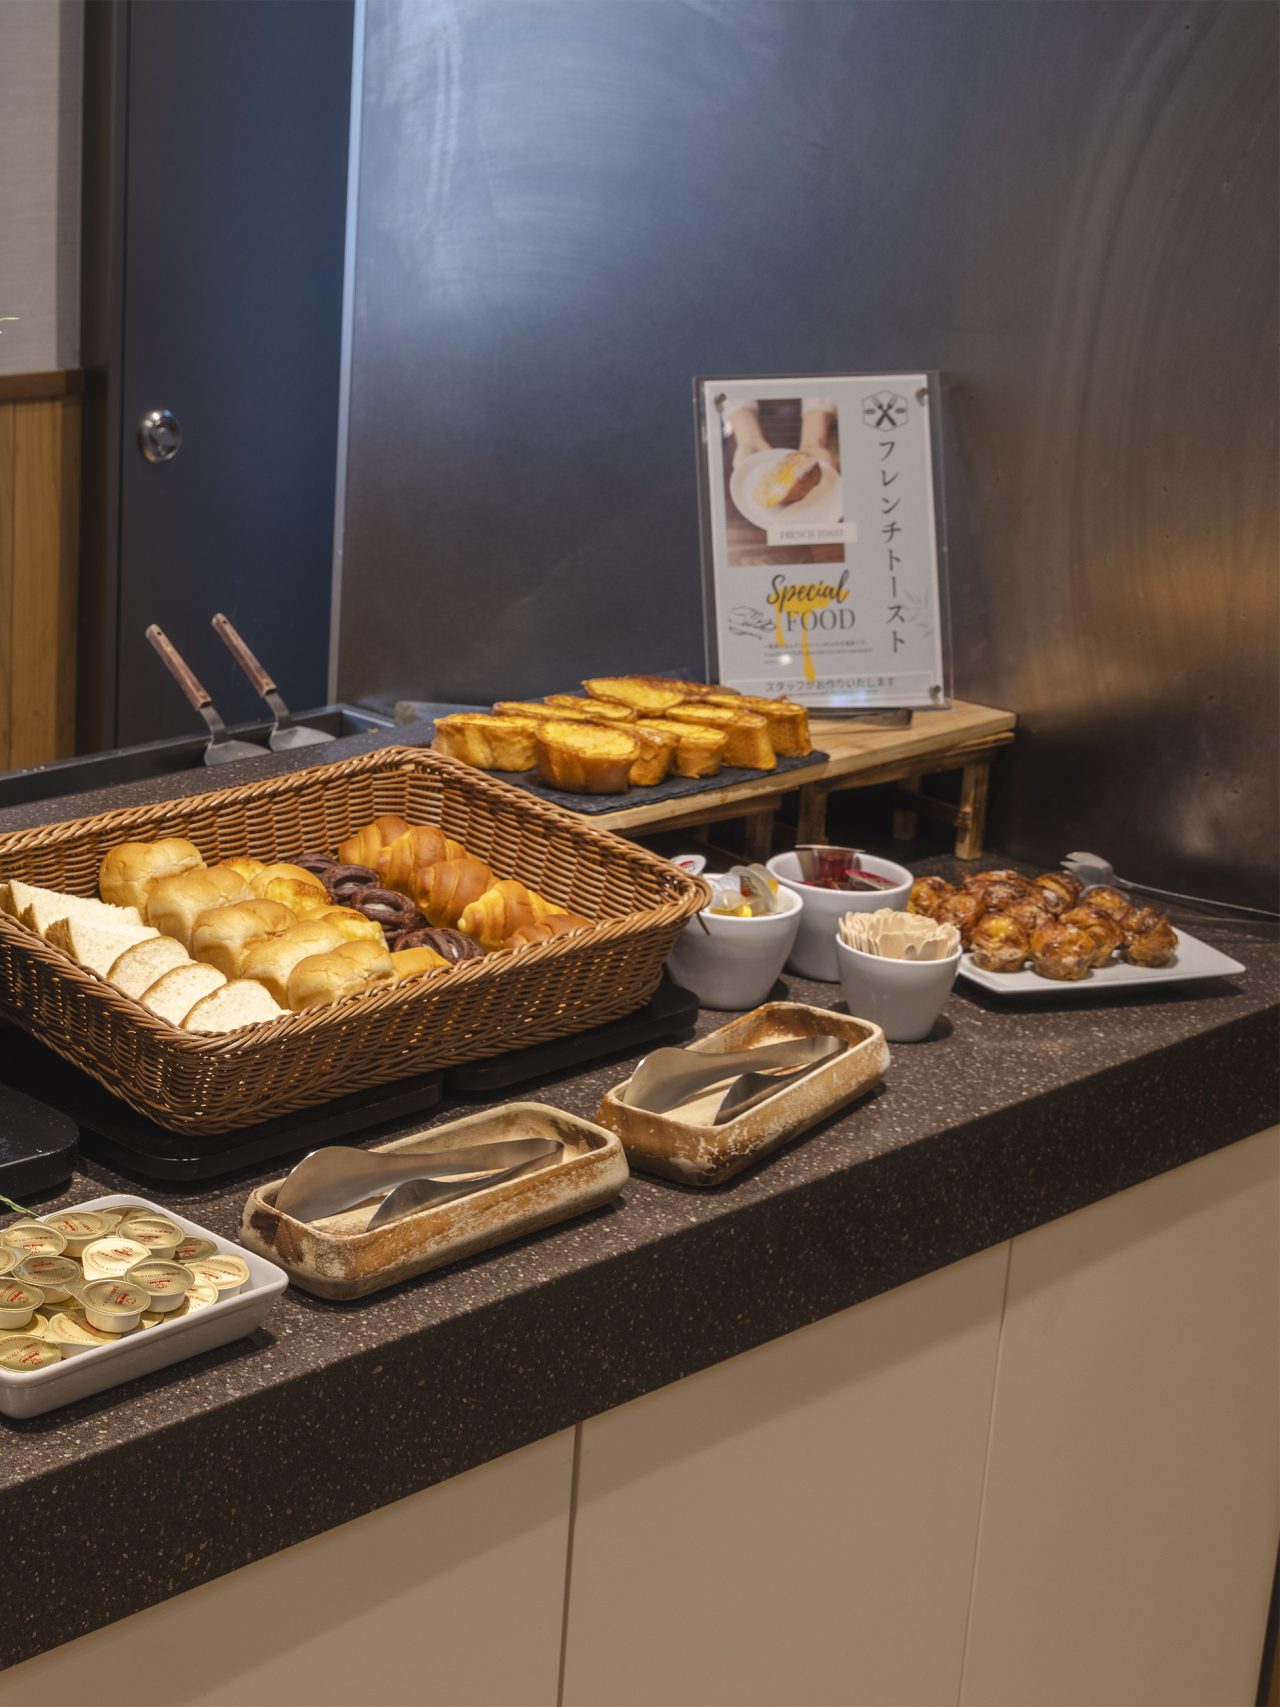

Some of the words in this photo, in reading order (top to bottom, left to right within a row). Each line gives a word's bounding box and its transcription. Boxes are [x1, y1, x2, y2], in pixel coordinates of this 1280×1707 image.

[780, 530, 816, 540] FRENCH
[817, 528, 844, 538] TOAST
[878, 441, 905, 653] フレンチトースト
[766, 569, 850, 613] Special
[786, 608, 856, 632] FOOD
[766, 677, 895, 692] スタッフがお作りいたします
